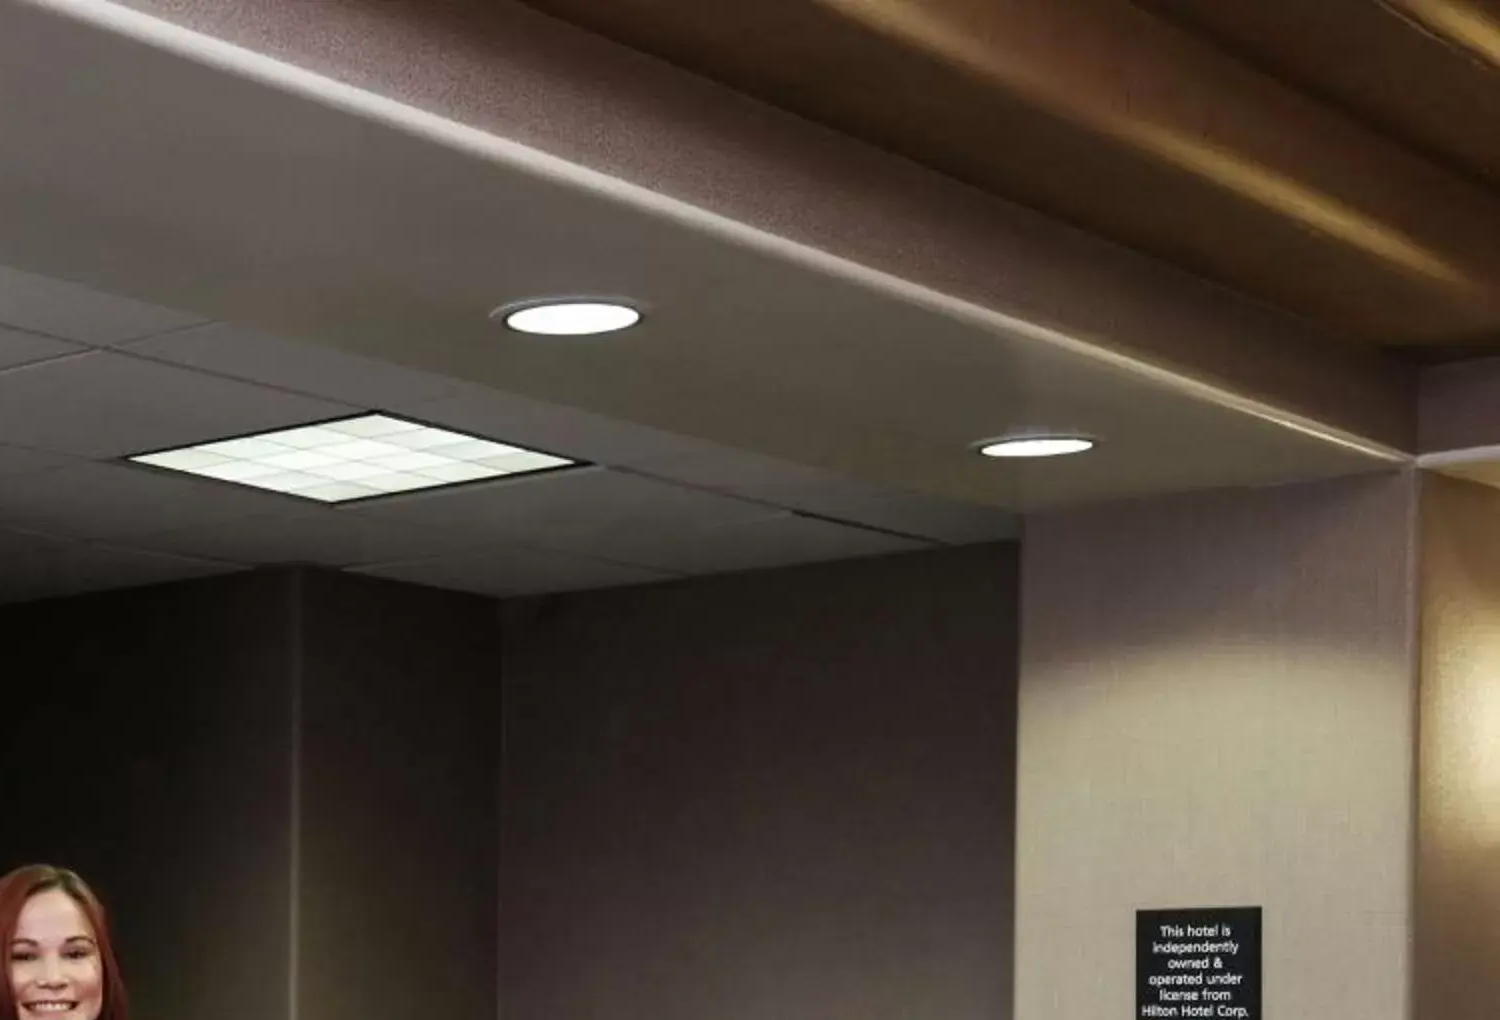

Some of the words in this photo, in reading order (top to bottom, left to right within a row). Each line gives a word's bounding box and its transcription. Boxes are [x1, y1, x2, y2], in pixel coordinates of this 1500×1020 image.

[1160, 924, 1184, 937] This
[1187, 923, 1218, 936] hotel
[1221, 923, 1231, 936] is
[1153, 940, 1239, 955] independently
[1167, 957, 1209, 969] owned
[1213, 956, 1223, 969] &
[1148, 972, 1203, 987] operated
[1206, 972, 1243, 985] under
[1159, 988, 1198, 1000] license
[1202, 988, 1231, 1001] from
[1141, 1004, 1177, 1016] Hilton
[1181, 1004, 1214, 1017] Hotel
[1217, 1004, 1249, 1020] Corp.
